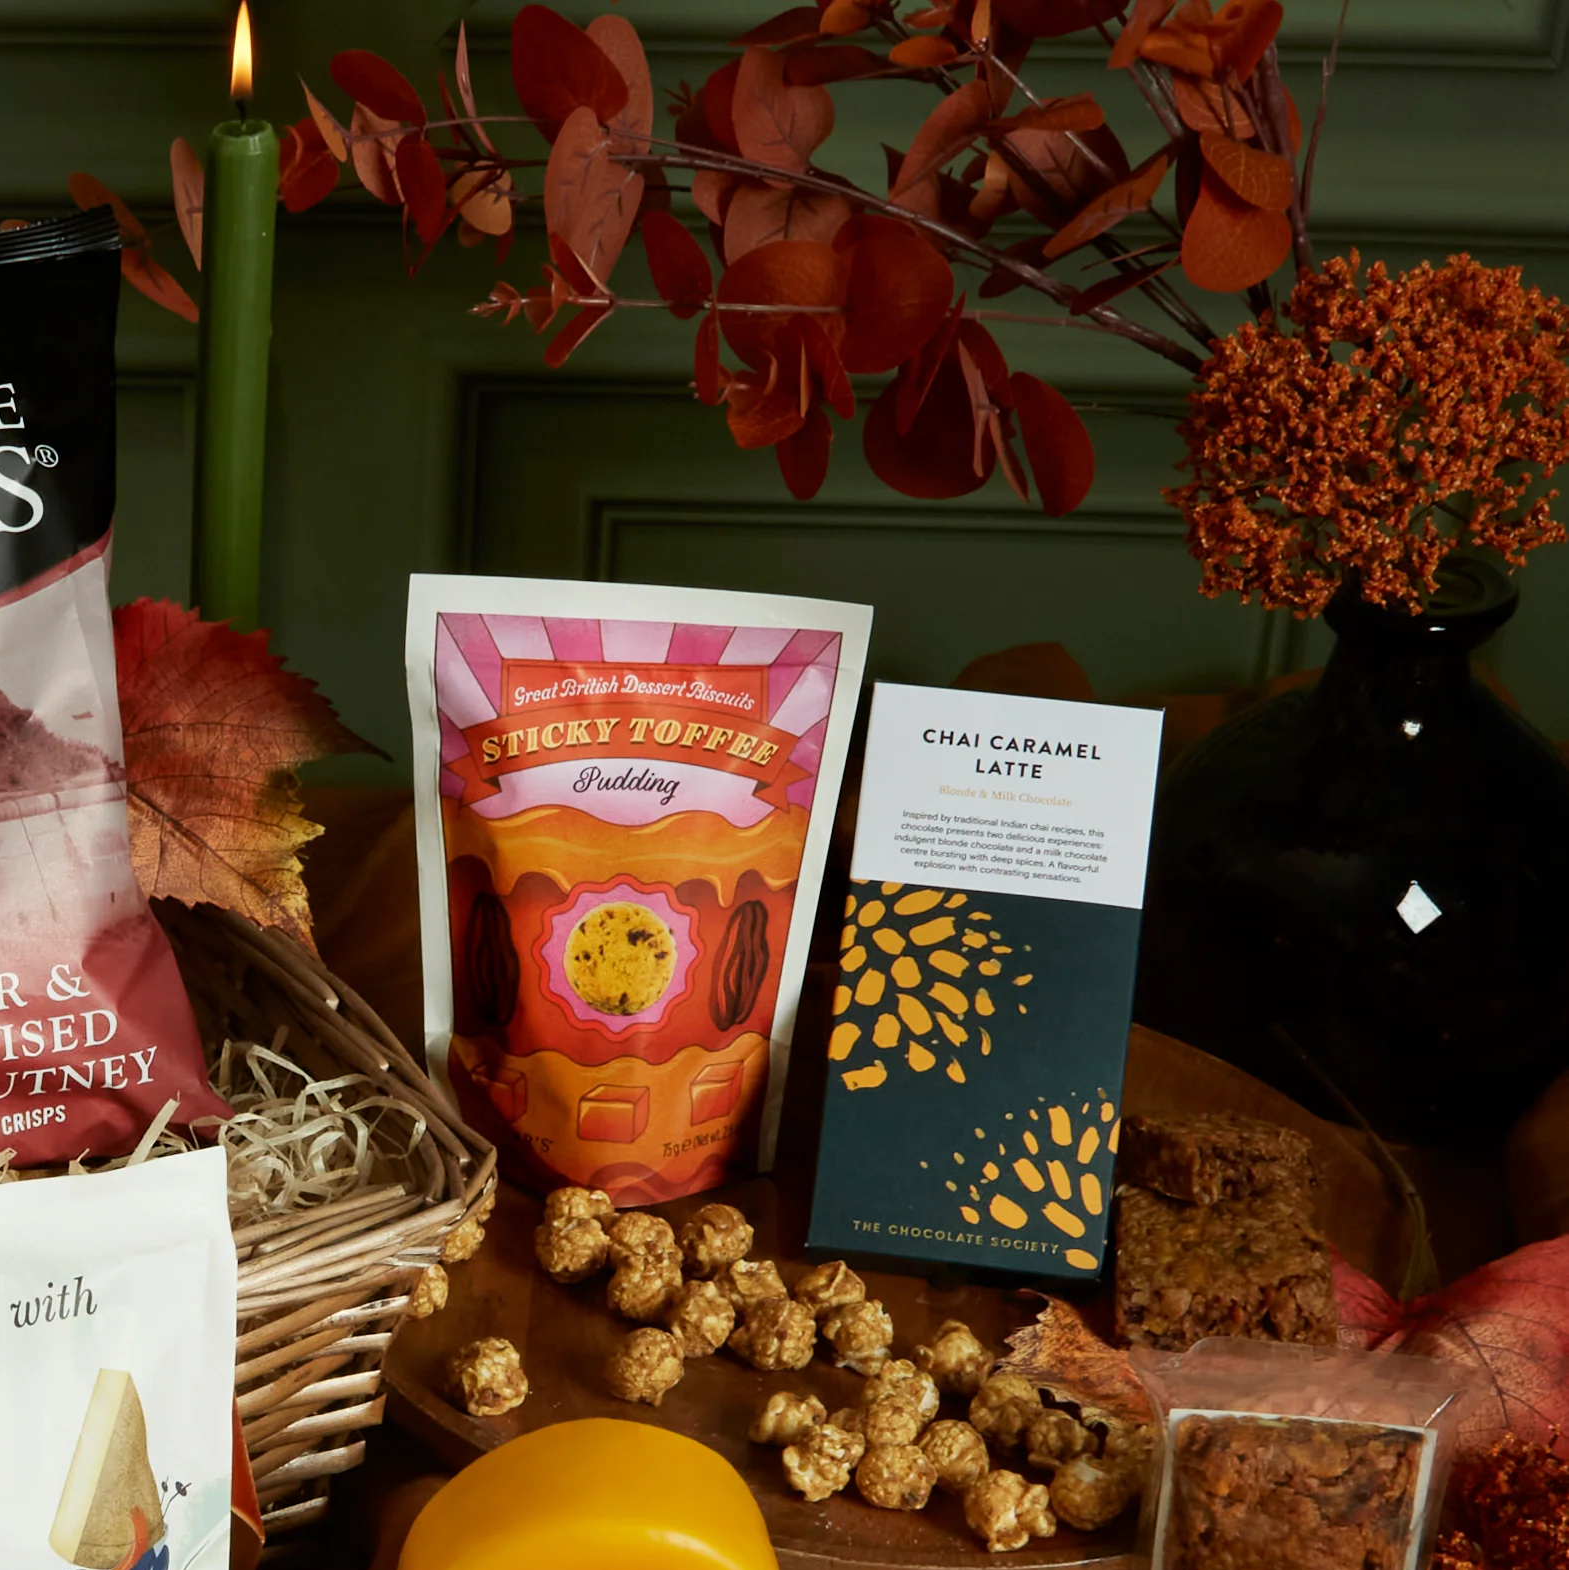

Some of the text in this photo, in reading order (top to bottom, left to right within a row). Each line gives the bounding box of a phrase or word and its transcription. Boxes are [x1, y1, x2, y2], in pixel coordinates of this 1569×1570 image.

[514, 674, 756, 711] Great British Dessert Biscuits
[481, 717, 780, 767] STICKY TOFFEE
[922, 728, 1102, 760] CHAI CARAMEL
[572, 766, 681, 806] Pudding
[975, 758, 1044, 779] LATTE
[939, 785, 976, 799] Blonde
[992, 790, 1016, 802] Milk
[1019, 793, 1073, 807] Chocolate
[941, 813, 952, 824] by
[953, 815, 998, 827] traditional
[45, 963, 91, 1002] &
[0, 1104, 67, 1135] CRISPS
[853, 1219, 1060, 1255] THE CHOCOLATE SOCIETY
[9, 1275, 98, 1328] with
